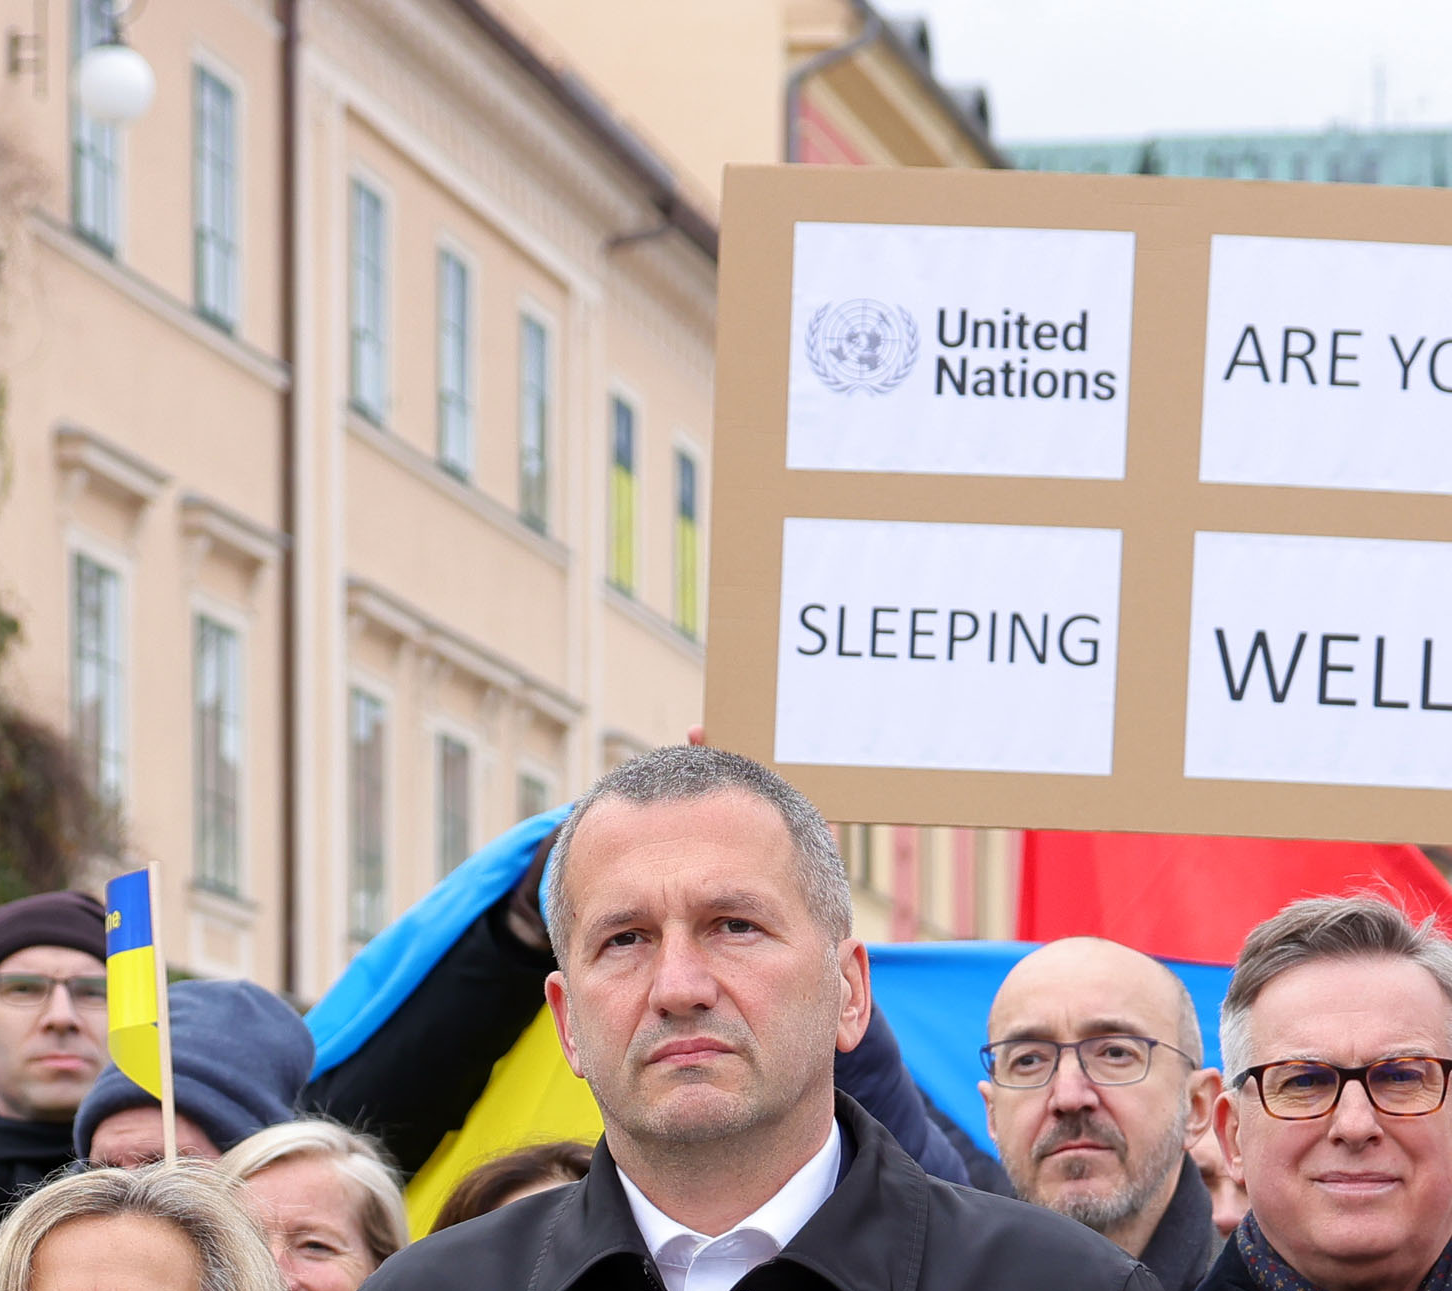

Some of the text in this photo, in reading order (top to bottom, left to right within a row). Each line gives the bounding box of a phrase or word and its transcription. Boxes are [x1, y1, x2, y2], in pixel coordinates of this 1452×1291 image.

[935, 307, 1089, 353] United
[1223, 324, 1363, 389] ARE
[934, 356, 1117, 402] Nations
[796, 603, 1101, 668] SLEEPING
